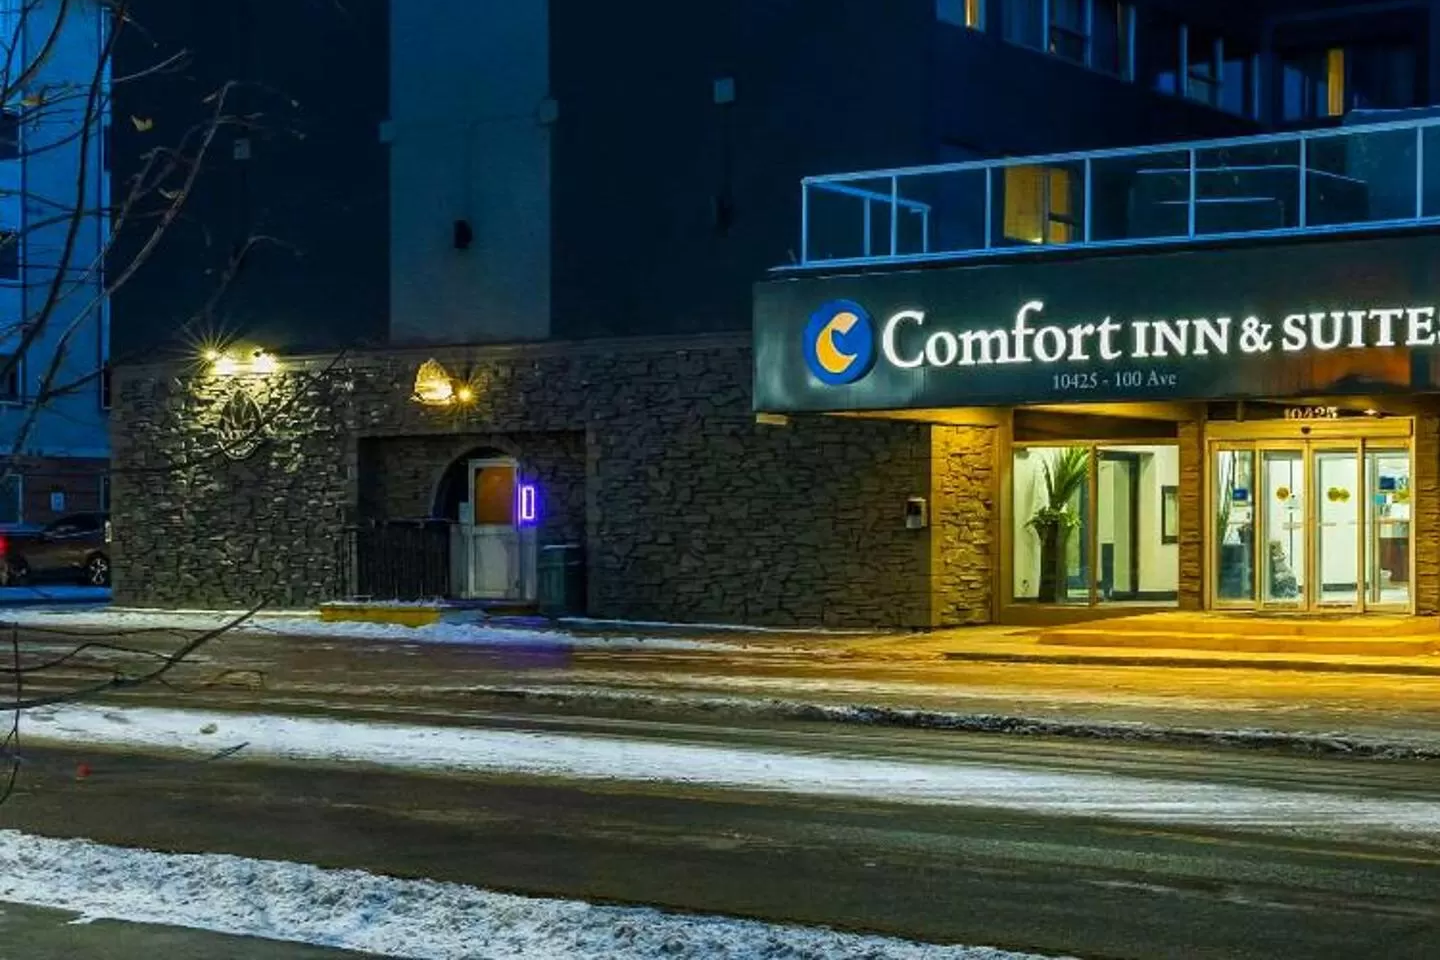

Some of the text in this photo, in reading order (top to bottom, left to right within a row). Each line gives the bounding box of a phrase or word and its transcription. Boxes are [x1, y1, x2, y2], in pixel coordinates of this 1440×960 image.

[882, 300, 1123, 368] Comfort
[1131, 317, 1232, 358] INN
[1239, 316, 1273, 353] &
[1053, 372, 1098, 389] 10425
[1115, 371, 1142, 387] 100
[1147, 369, 1177, 386] Ave
[1284, 406, 1338, 420] 10425
